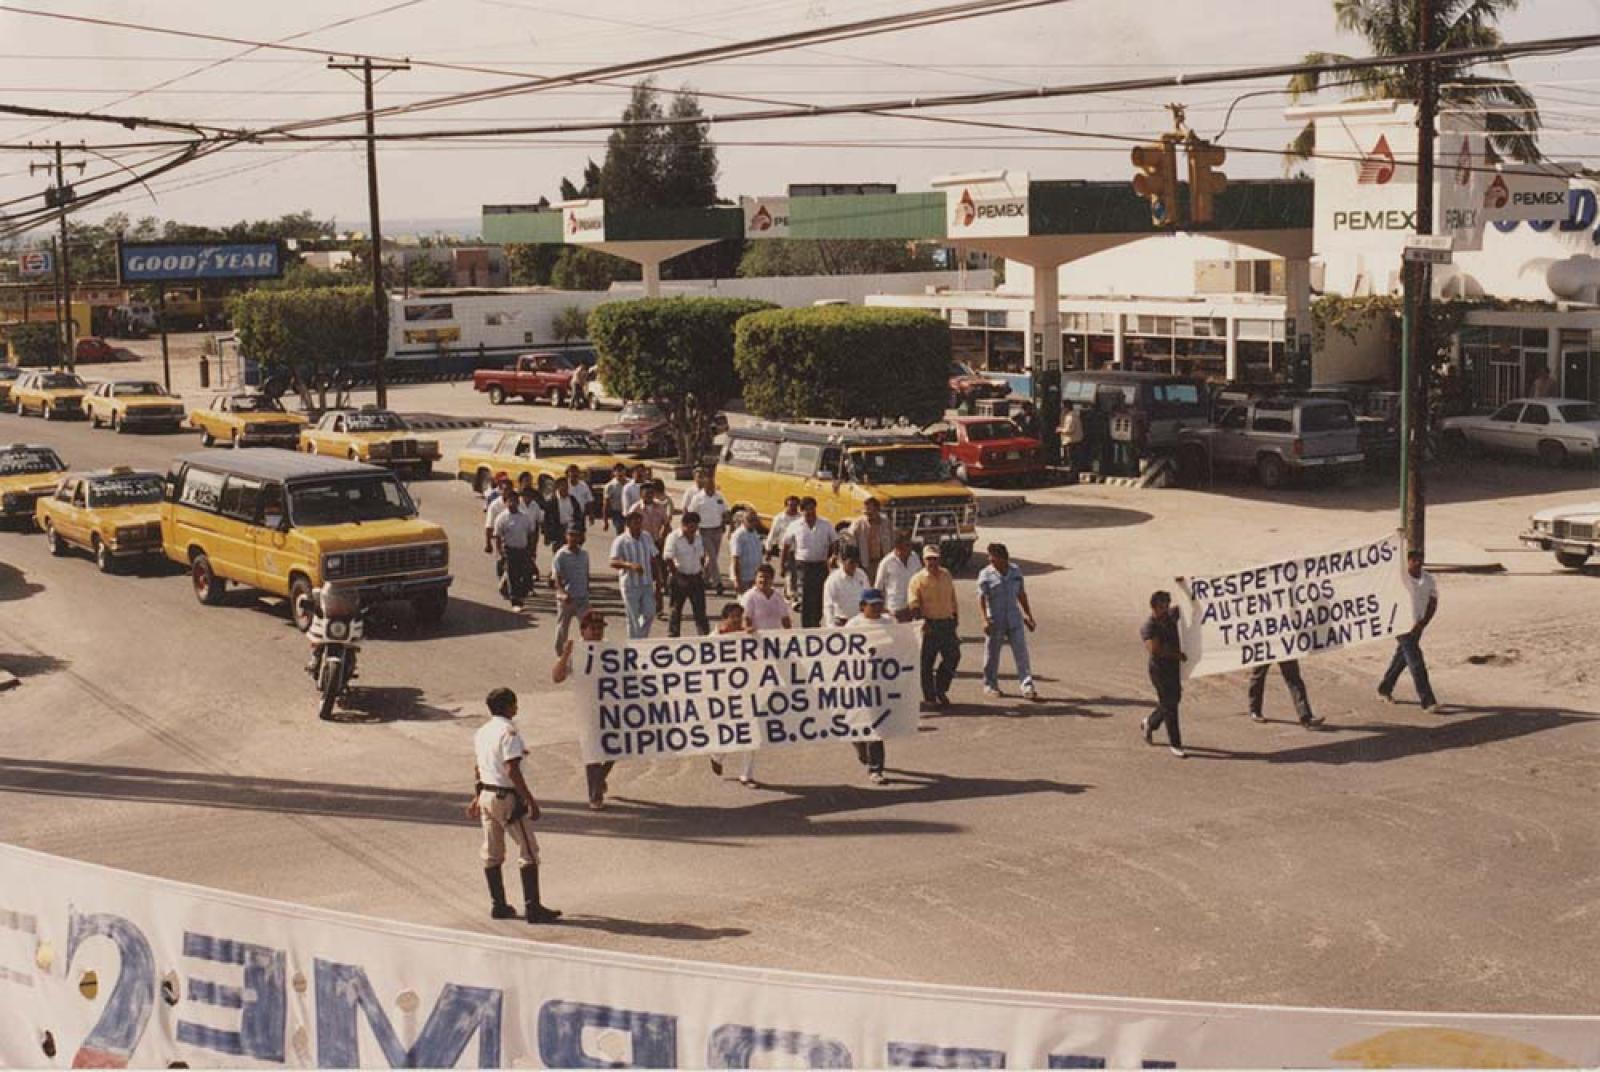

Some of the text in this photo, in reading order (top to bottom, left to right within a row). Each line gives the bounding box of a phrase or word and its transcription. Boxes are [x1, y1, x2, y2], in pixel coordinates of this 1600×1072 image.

[977, 203, 1025, 219] PEMEX
[1513, 191, 1565, 205] PEMEX
[1333, 210, 1417, 230] PEMEX
[1303, 549, 1355, 578] PARA
[1201, 579, 1335, 624] AUTENTICOS
[1219, 594, 1380, 645] TRABAJADORES
[1242, 642, 1276, 665] DEL
[597, 658, 914, 701] RESPETO A LA AUTO-
[600, 685, 901, 729] NOMIA DE LOS MUNI-
[601, 725, 710, 755] CIPIOS
[717, 723, 752, 745] DE
